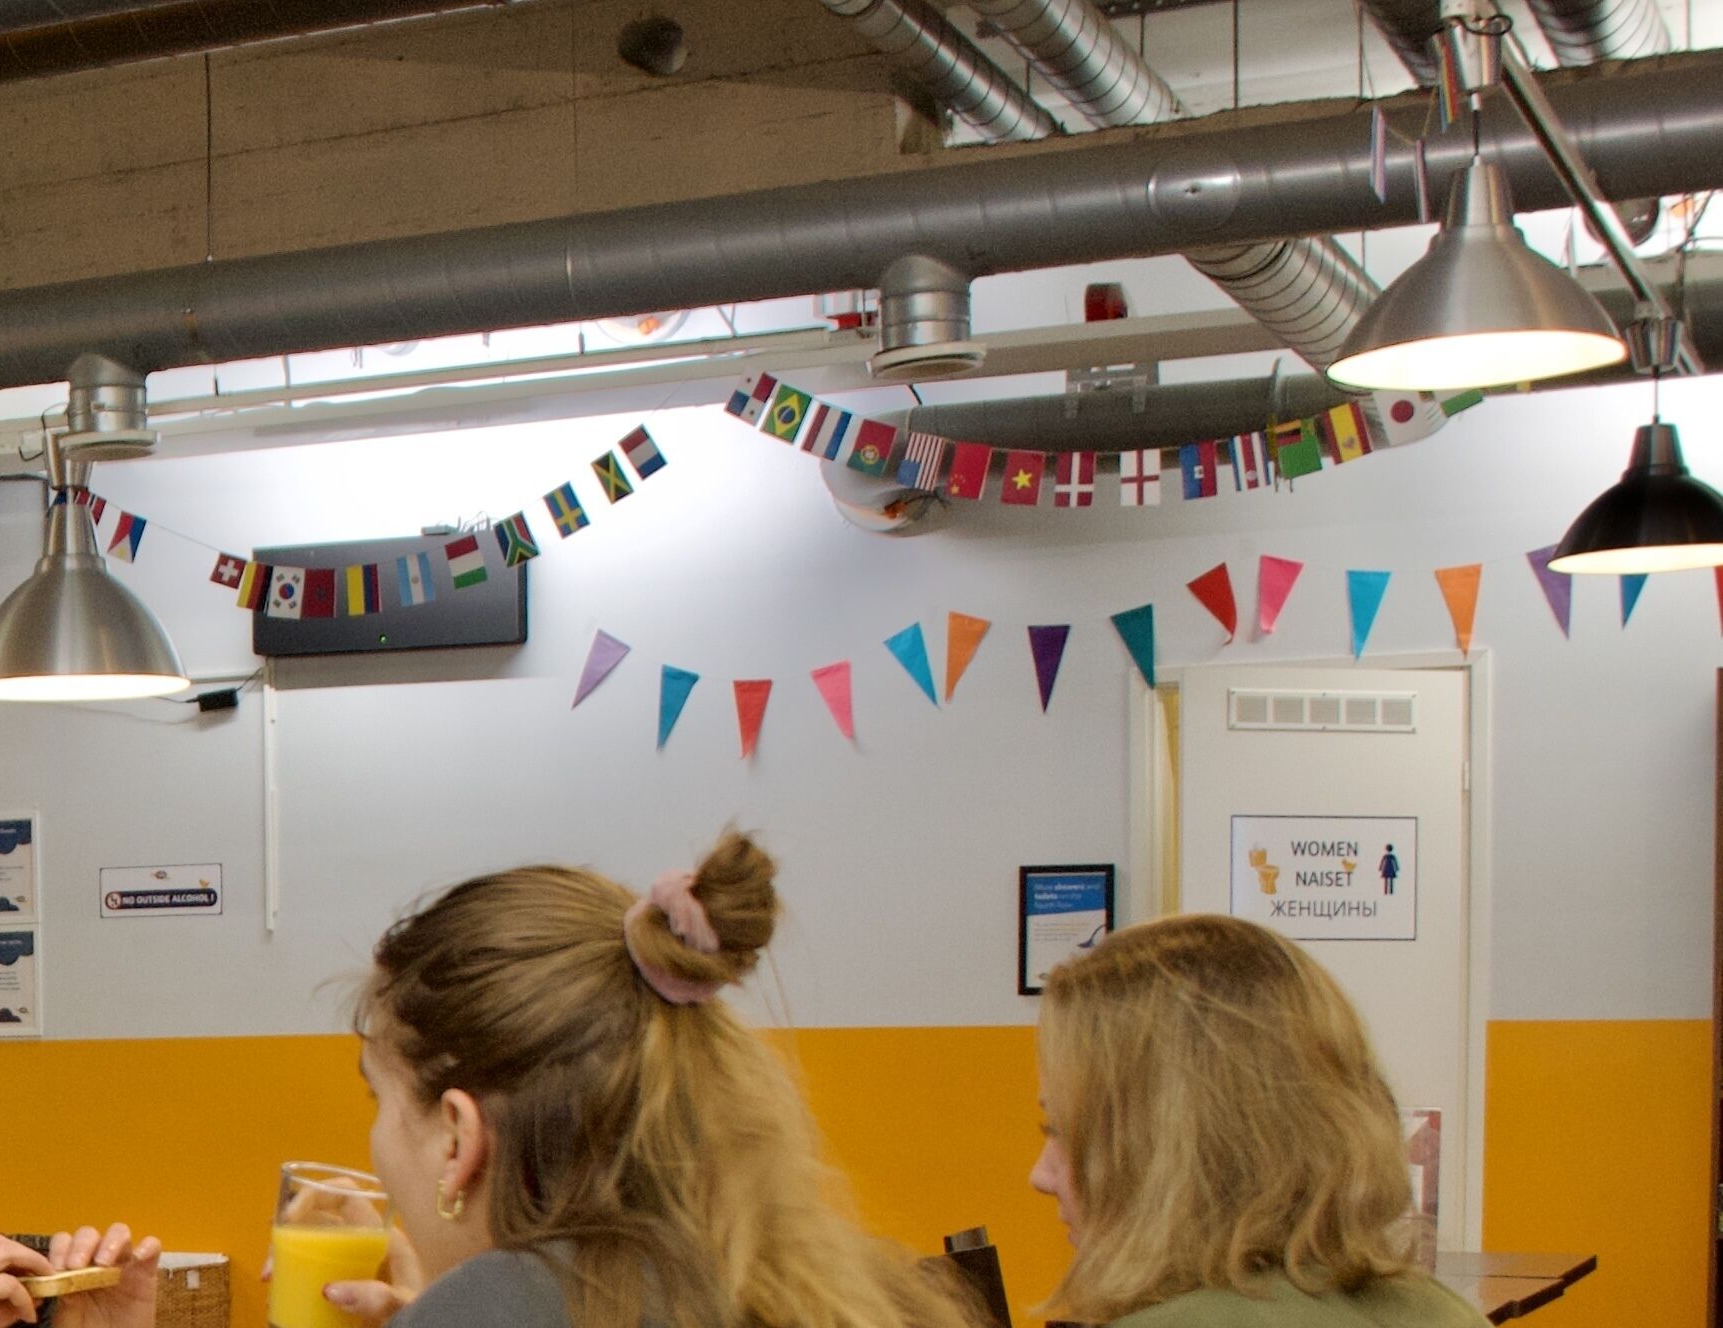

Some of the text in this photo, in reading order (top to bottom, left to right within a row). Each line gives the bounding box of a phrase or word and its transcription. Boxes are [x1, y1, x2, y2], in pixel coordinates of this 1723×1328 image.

[1290, 840, 1359, 857] WOMEN
[1295, 871, 1354, 887] NAISET
[122, 895, 135, 904] NO
[136, 894, 170, 904] OUTSIDE
[171, 892, 210, 902] ALCOHOL
[1270, 900, 1377, 920] ЖЕНЩИНЫ
